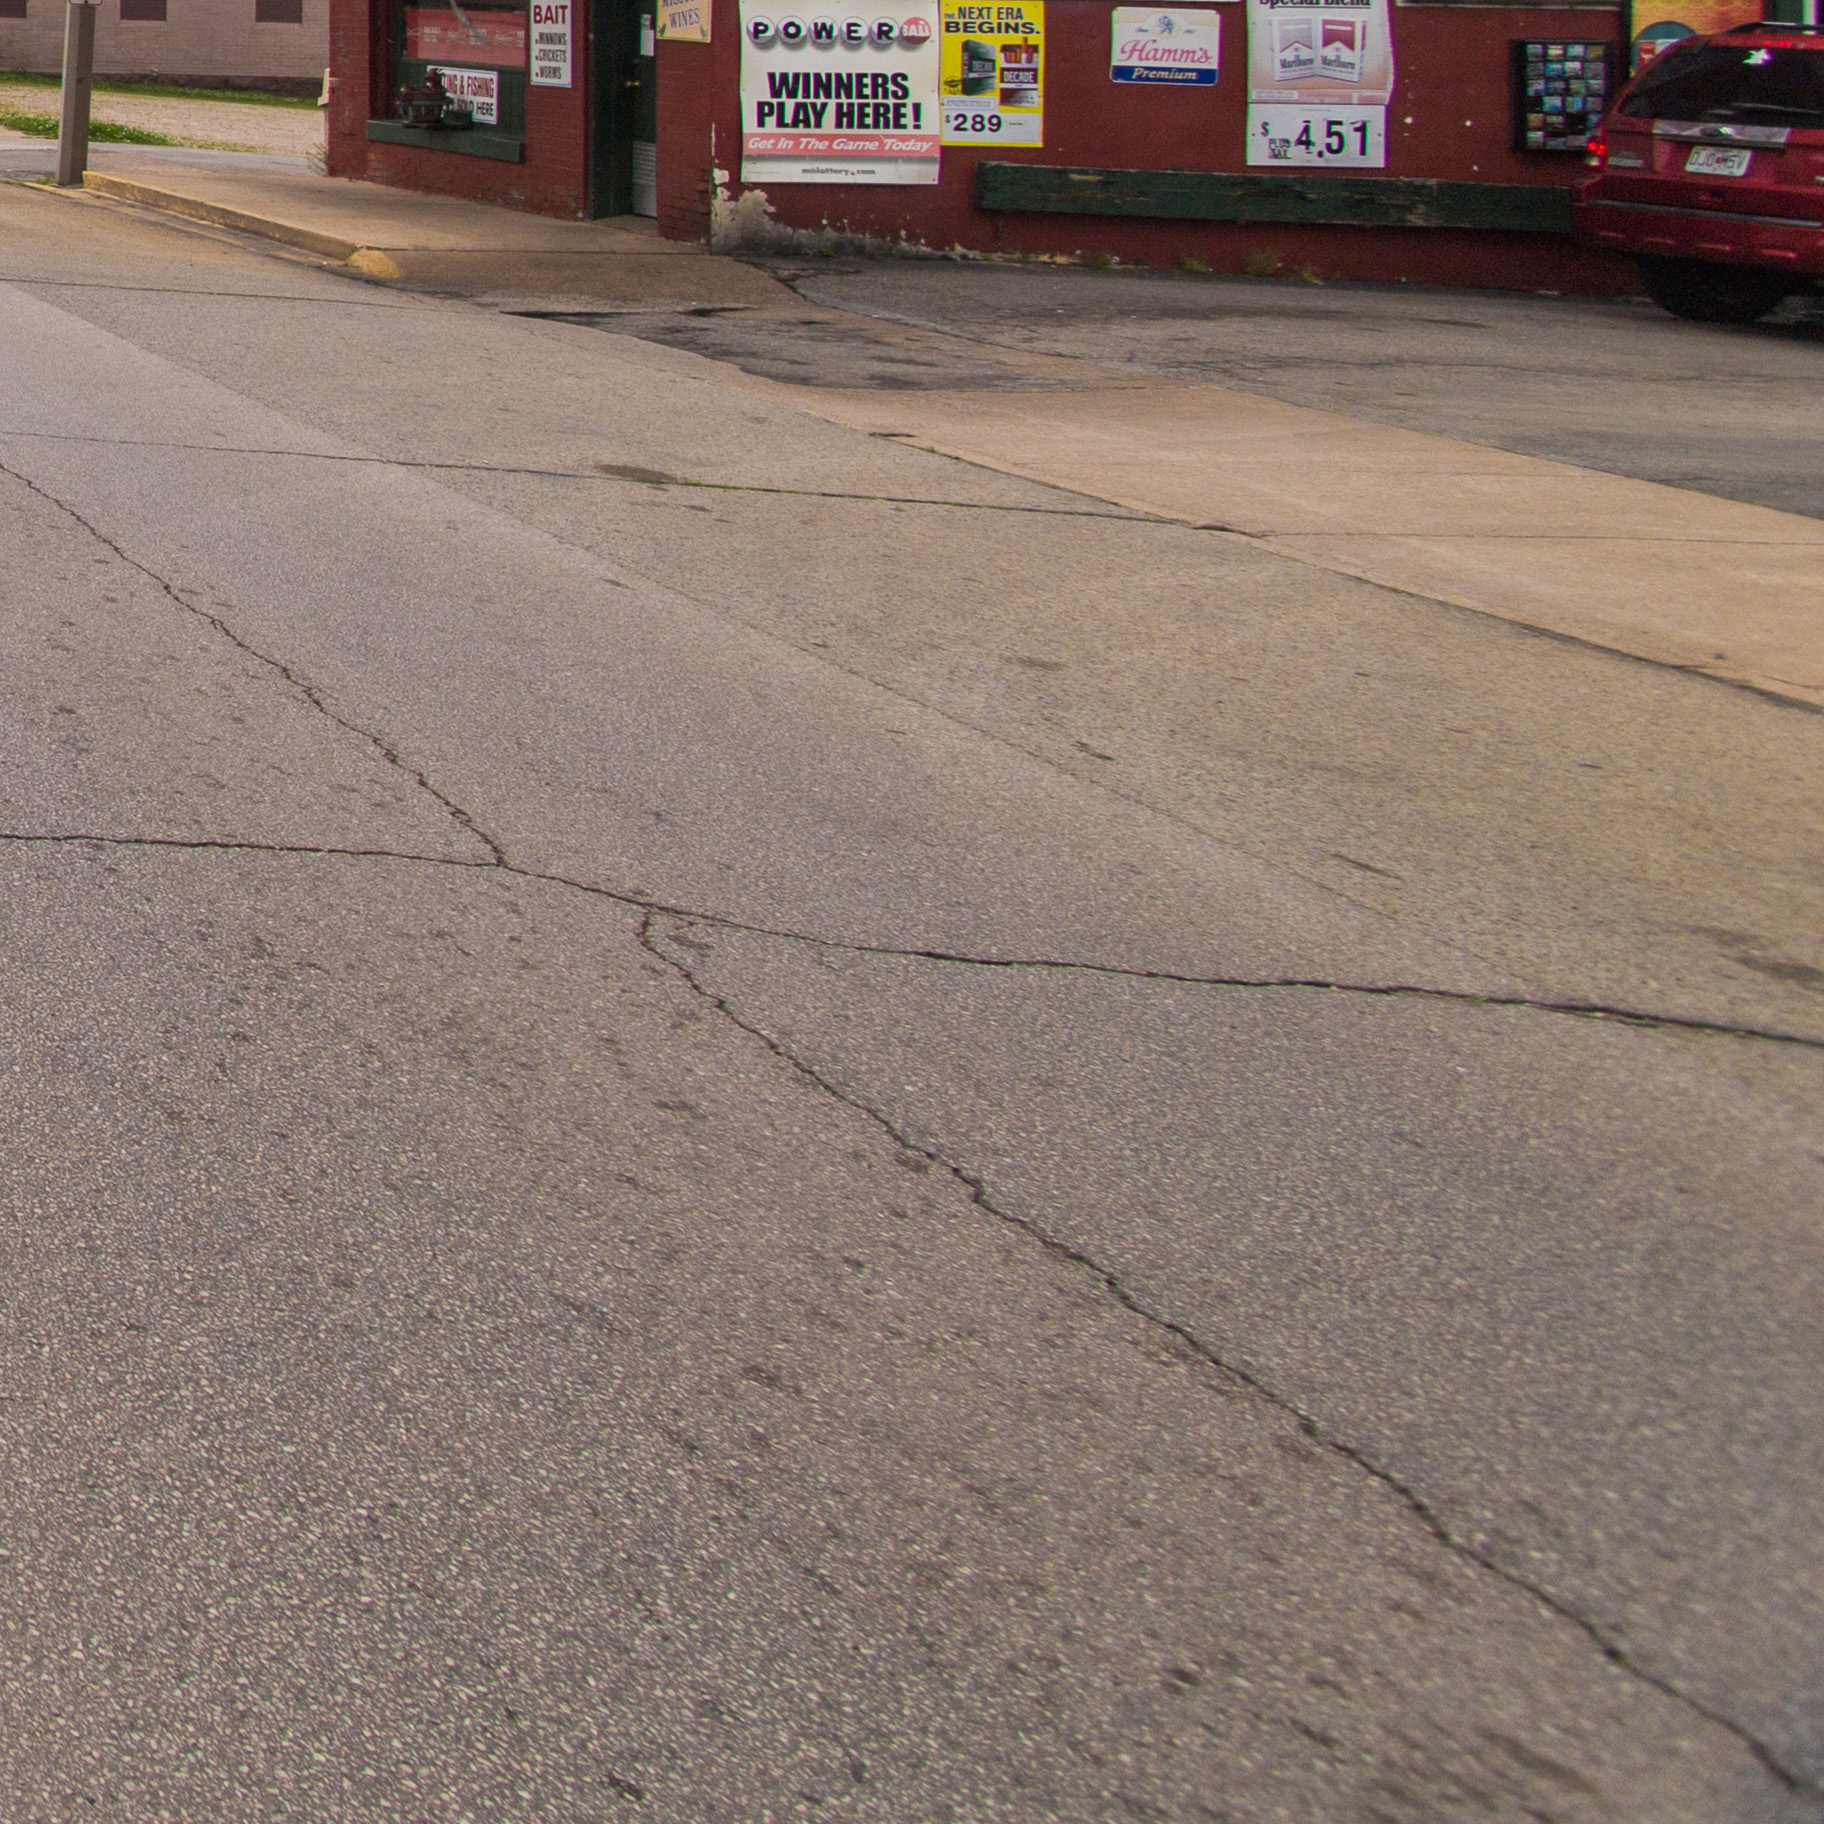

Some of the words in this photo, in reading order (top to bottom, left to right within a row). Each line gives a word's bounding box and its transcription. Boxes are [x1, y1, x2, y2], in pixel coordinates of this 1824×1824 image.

[533, 5, 568, 25] BAIT
[669, 8, 701, 29] WINES
[957, 6, 993, 19] NEXT
[997, 7, 1024, 20] ERA
[944, 21, 1041, 34] BEGINS.
[1118, 39, 1213, 64] Hamm's
[1003, 71, 1035, 82] DECADE
[1132, 68, 1198, 80] Premium
[767, 72, 910, 100] WINNERS
[476, 101, 494, 117] HERE
[756, 101, 829, 128] PLAY
[834, 102, 922, 129] HERE!
[953, 113, 1002, 132] 289
[748, 137, 775, 149] Get
[777, 138, 793, 149] In
[799, 138, 829, 149] The
[832, 138, 879, 150] Game
[883, 138, 933, 152] Today
[1294, 120, 1367, 158] 4.51
